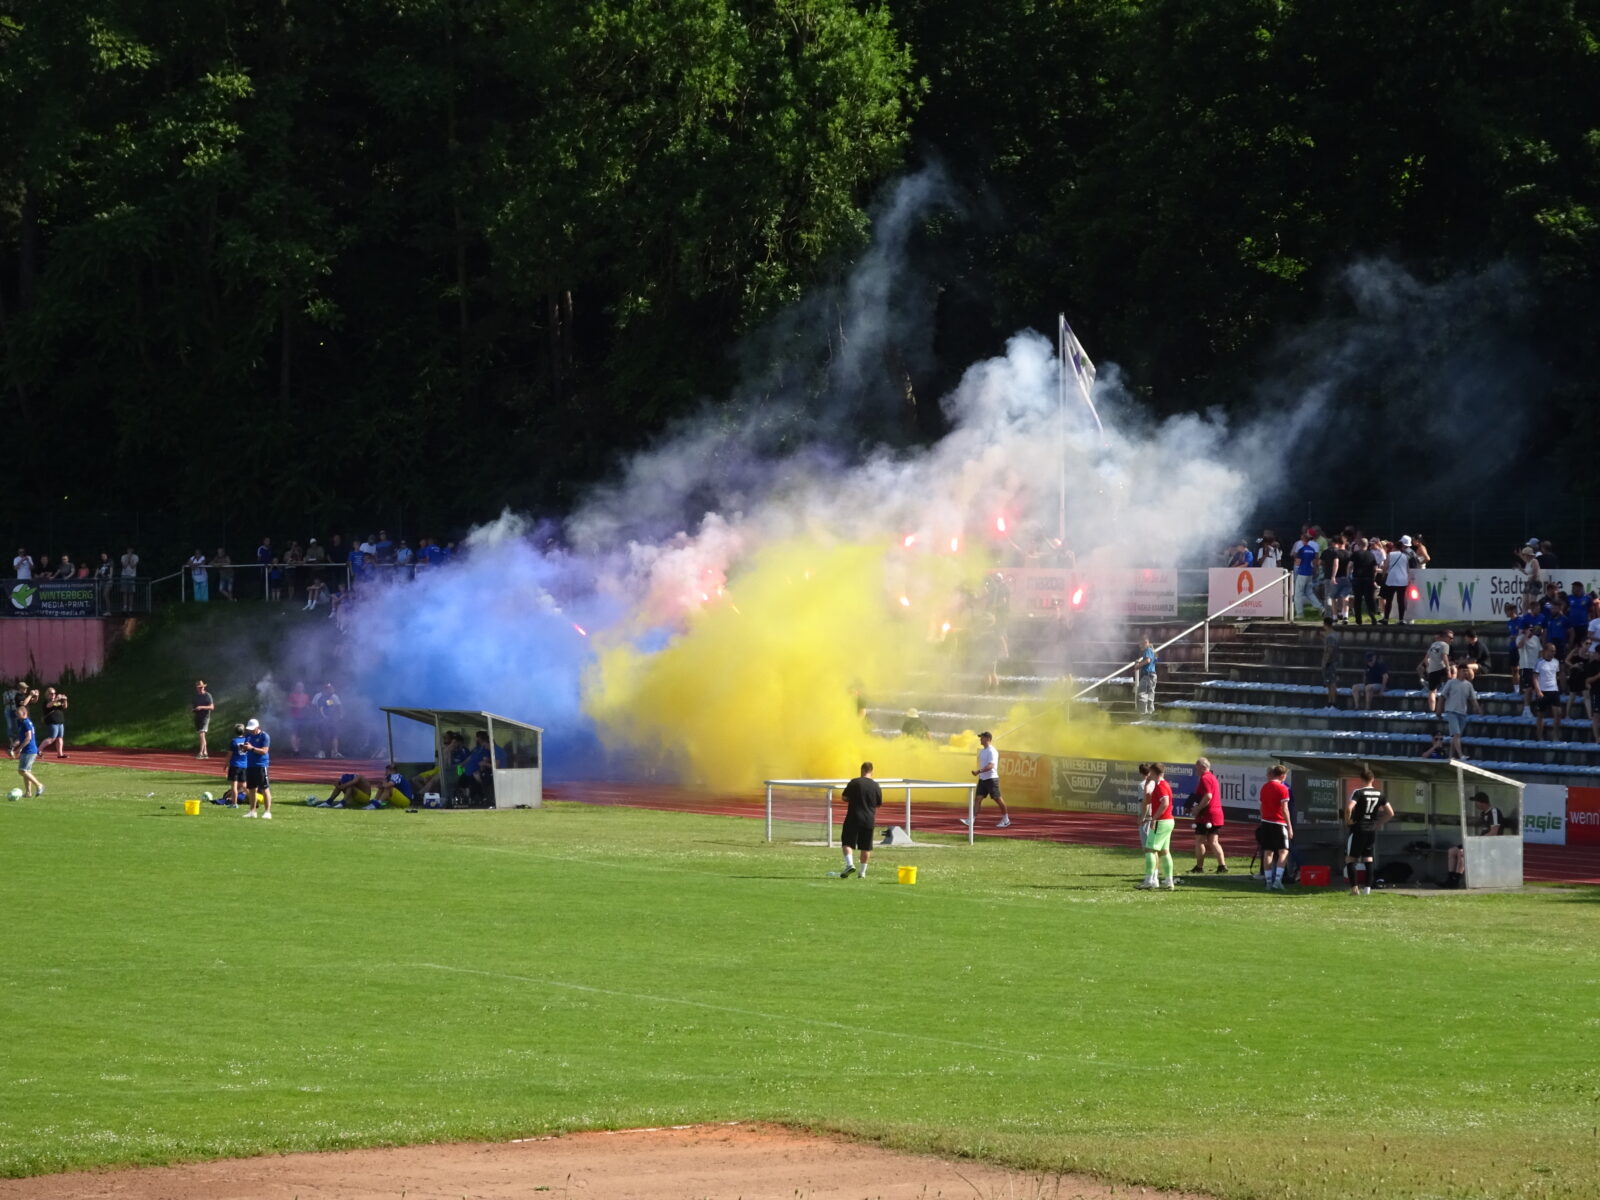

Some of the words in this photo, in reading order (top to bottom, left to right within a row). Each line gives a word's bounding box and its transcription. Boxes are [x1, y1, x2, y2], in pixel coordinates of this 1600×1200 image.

[39, 590, 94, 601] WINTERBERG
[1062, 759, 1107, 773] WIESECKER
[1071, 776, 1100, 789] GROUP
[1365, 797, 1380, 814] 17
